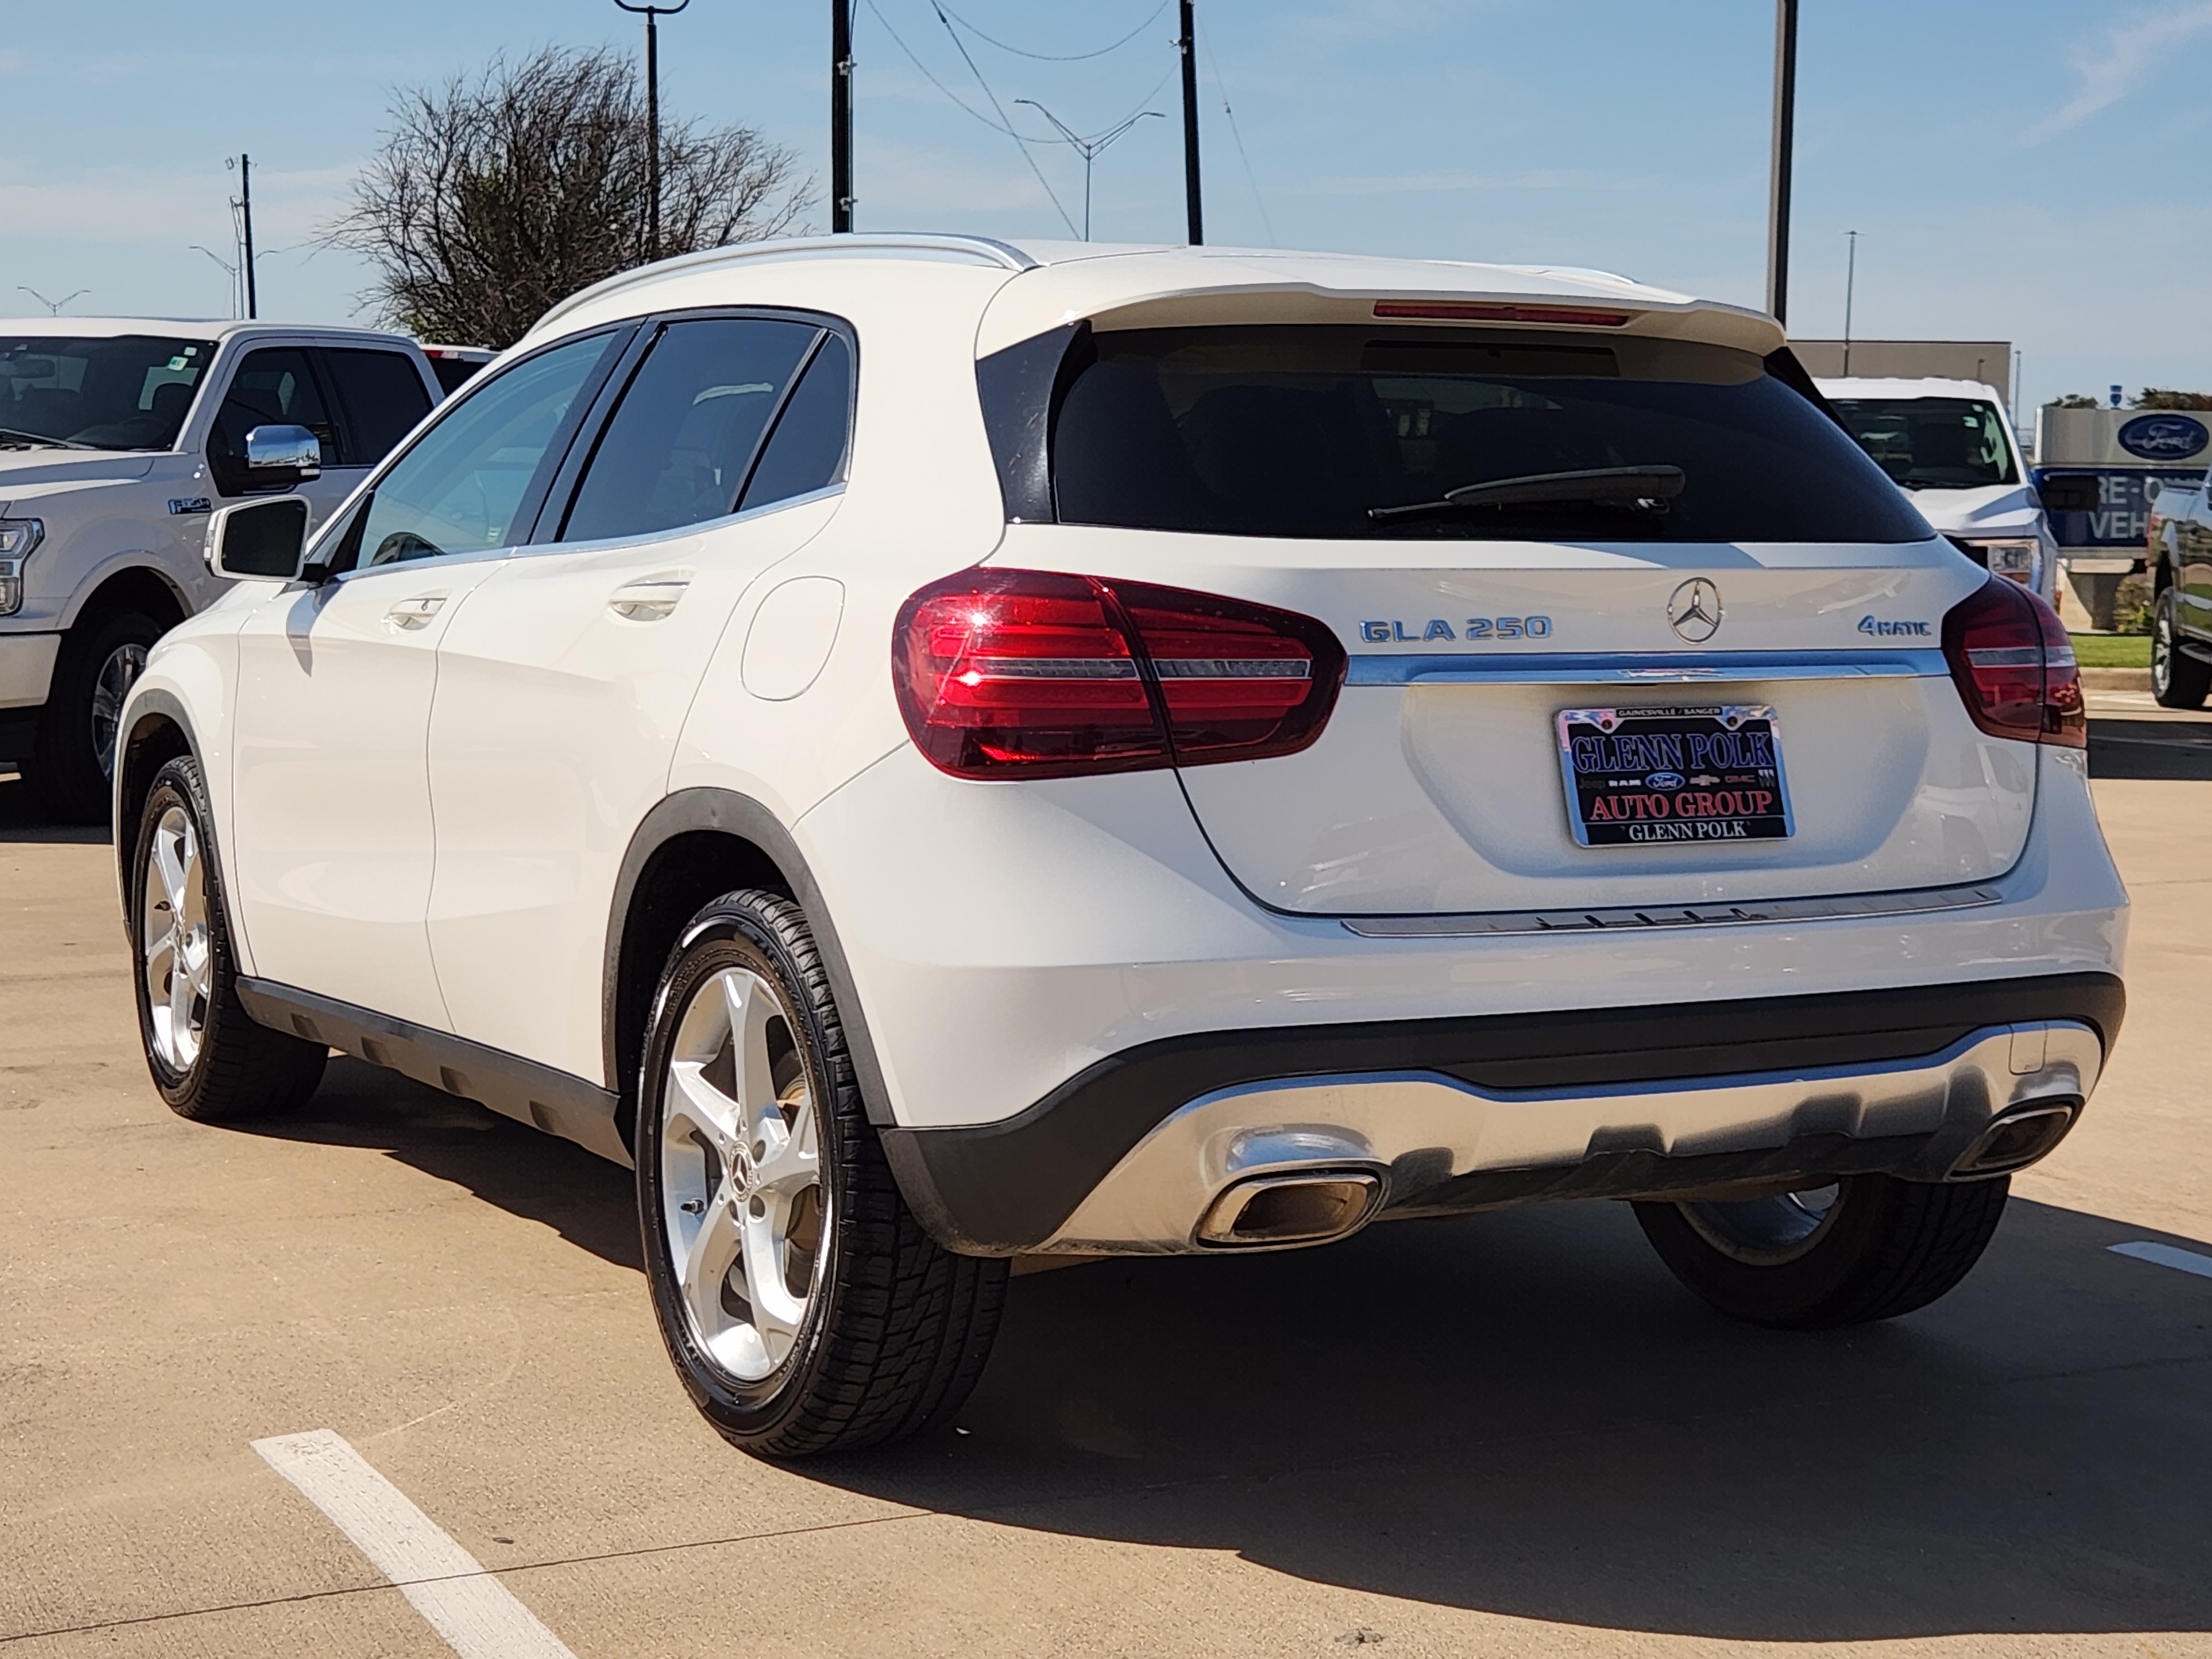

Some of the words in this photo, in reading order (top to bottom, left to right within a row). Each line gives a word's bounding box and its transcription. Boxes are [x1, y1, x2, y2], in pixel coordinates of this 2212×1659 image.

[2125, 423, 2195, 449] Ford
[2098, 476, 2164, 504] RE-O
[2088, 510, 2150, 539] VEH
[1360, 619, 1457, 643] GLA
[1466, 615, 1552, 640] 250
[1858, 615, 1932, 636] 4MATIC
[1618, 708, 1676, 717] GAINESVILLE
[1571, 734, 1684, 773] GLENN
[1686, 732, 1775, 769] POLK
[1724, 775, 1756, 783] GMC
[1589, 794, 1670, 820] AUTO
[1675, 791, 1773, 817] GROUP
[1629, 823, 1694, 841] GLENN
[1695, 821, 1747, 838] POLK
